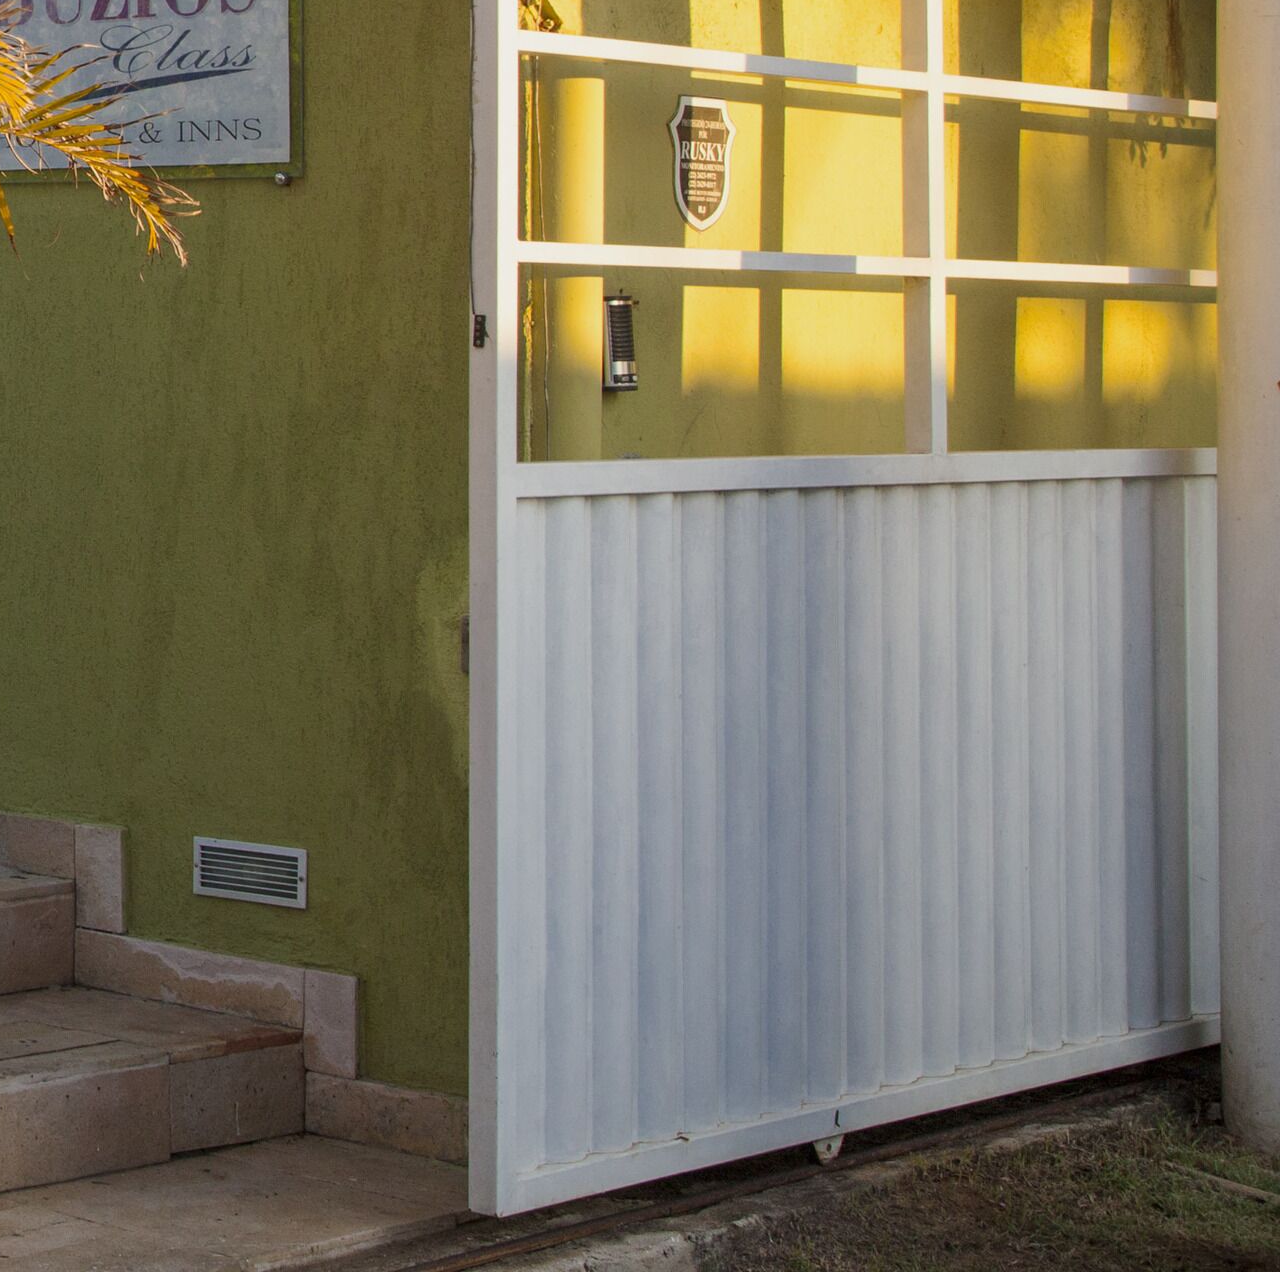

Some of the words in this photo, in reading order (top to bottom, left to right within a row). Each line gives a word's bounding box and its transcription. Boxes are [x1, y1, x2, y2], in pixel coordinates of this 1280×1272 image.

[100, 24, 256, 79] Class
[140, 121, 162, 144] &
[177, 118, 263, 143] INNS
[681, 140, 726, 162] RUSKY
